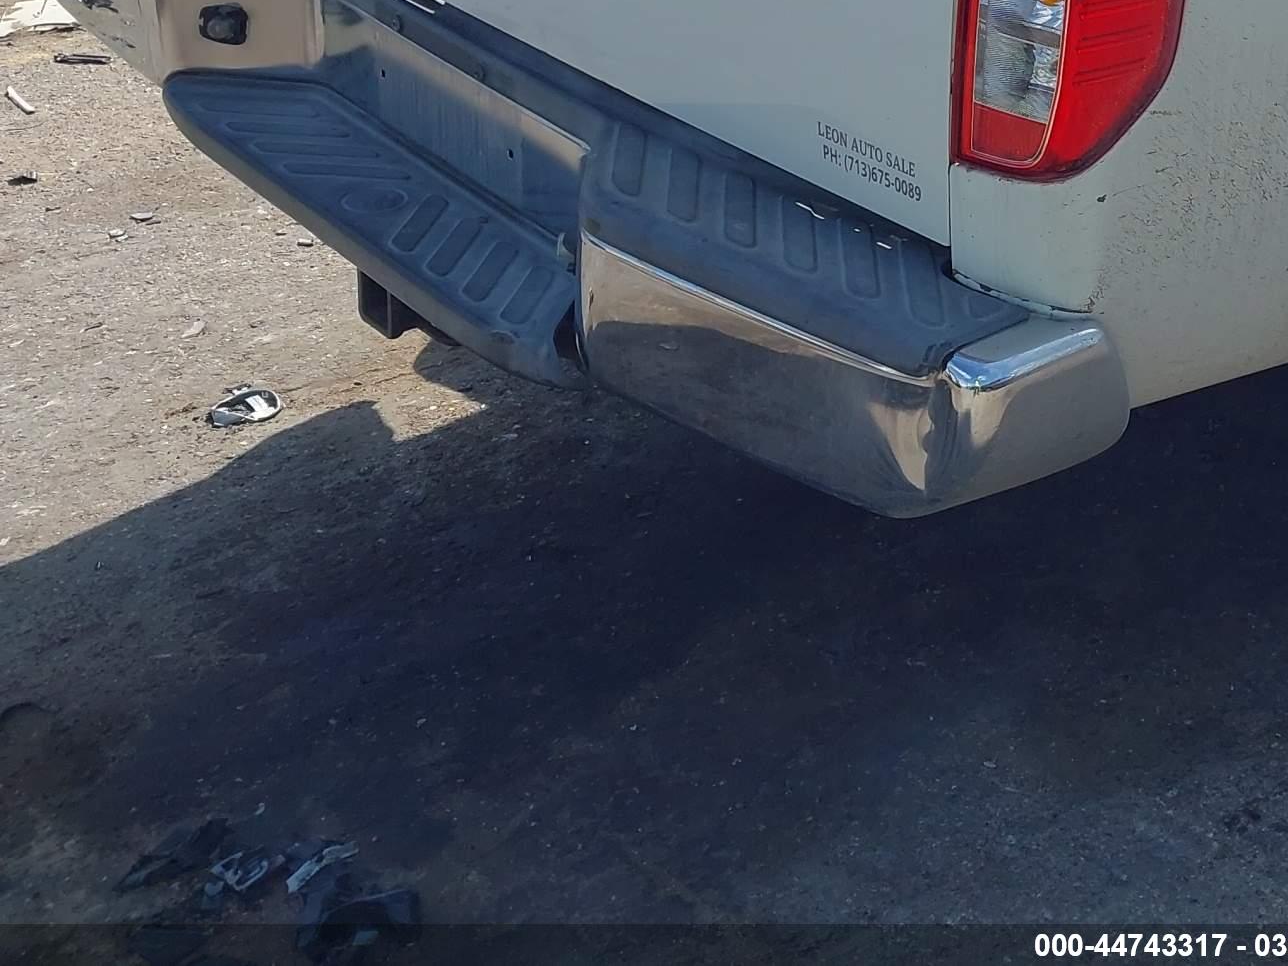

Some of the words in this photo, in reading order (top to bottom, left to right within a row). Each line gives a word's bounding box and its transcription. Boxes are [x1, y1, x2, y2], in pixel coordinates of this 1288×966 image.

[817, 121, 848, 148] LEON
[851, 137, 883, 163] AUTO
[886, 152, 916, 178] SALE
[823, 144, 842, 167] PH:
[844, 153, 922, 202] (713)675-0089
